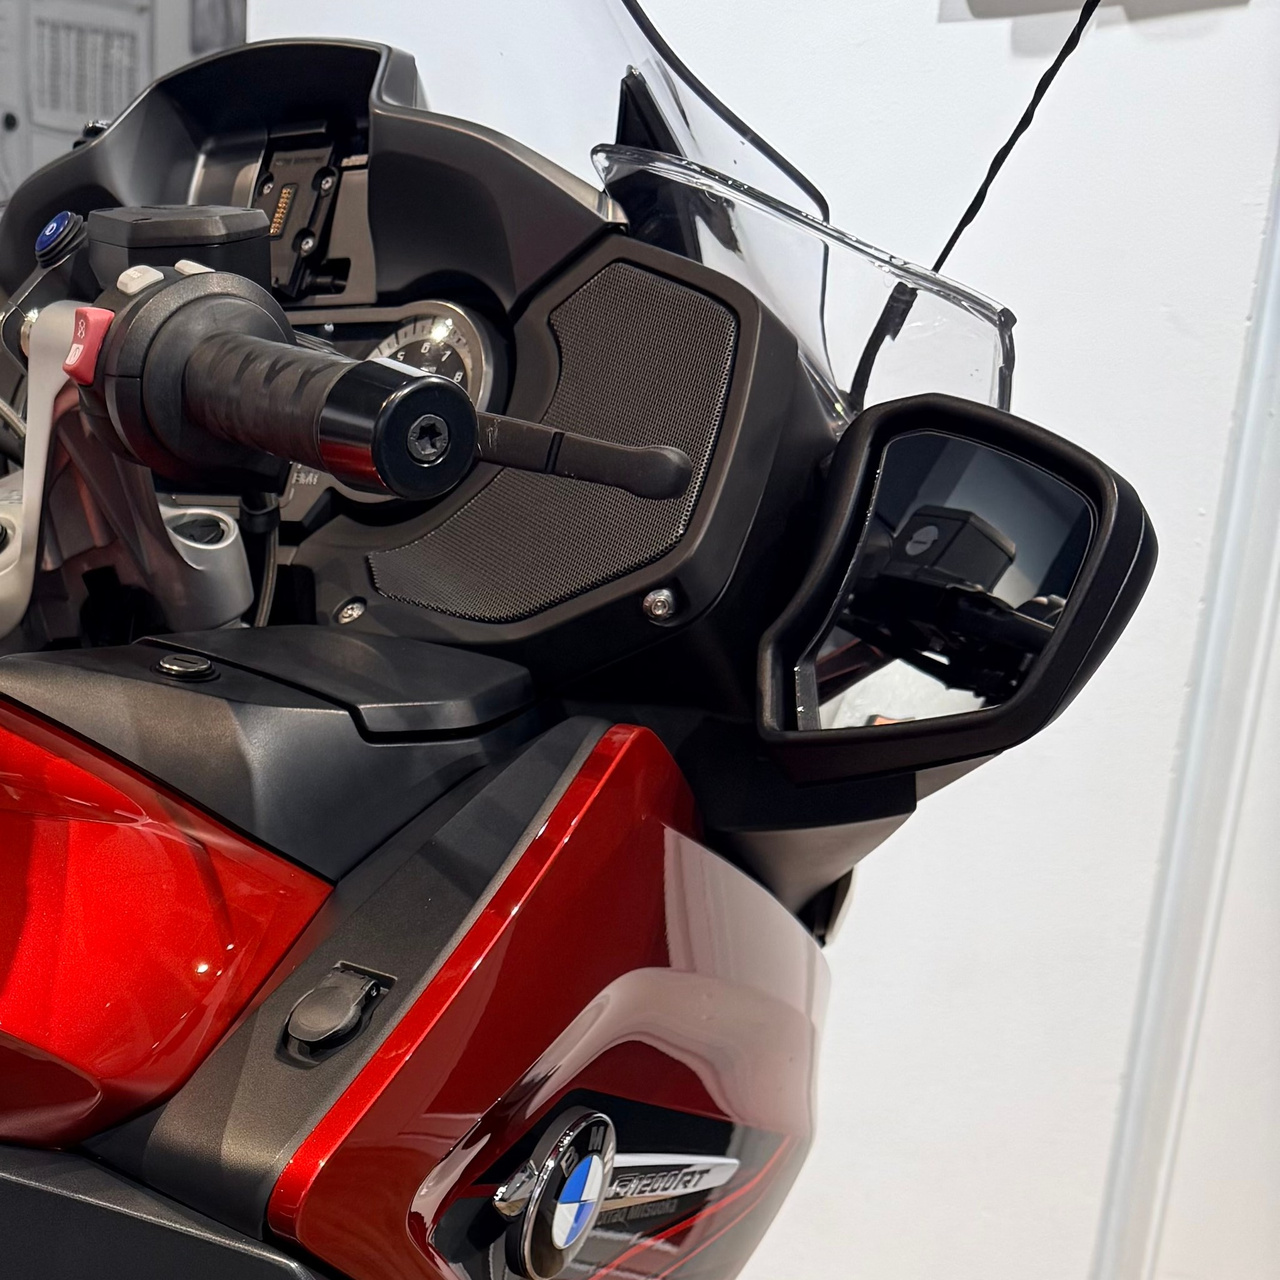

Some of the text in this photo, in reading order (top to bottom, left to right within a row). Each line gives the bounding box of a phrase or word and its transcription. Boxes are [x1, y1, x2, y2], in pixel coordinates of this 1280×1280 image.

[421, 342, 431, 353] 6
[396, 351, 405, 361] 5
[441, 350, 451, 361] 7
[453, 371, 463, 383] 8
